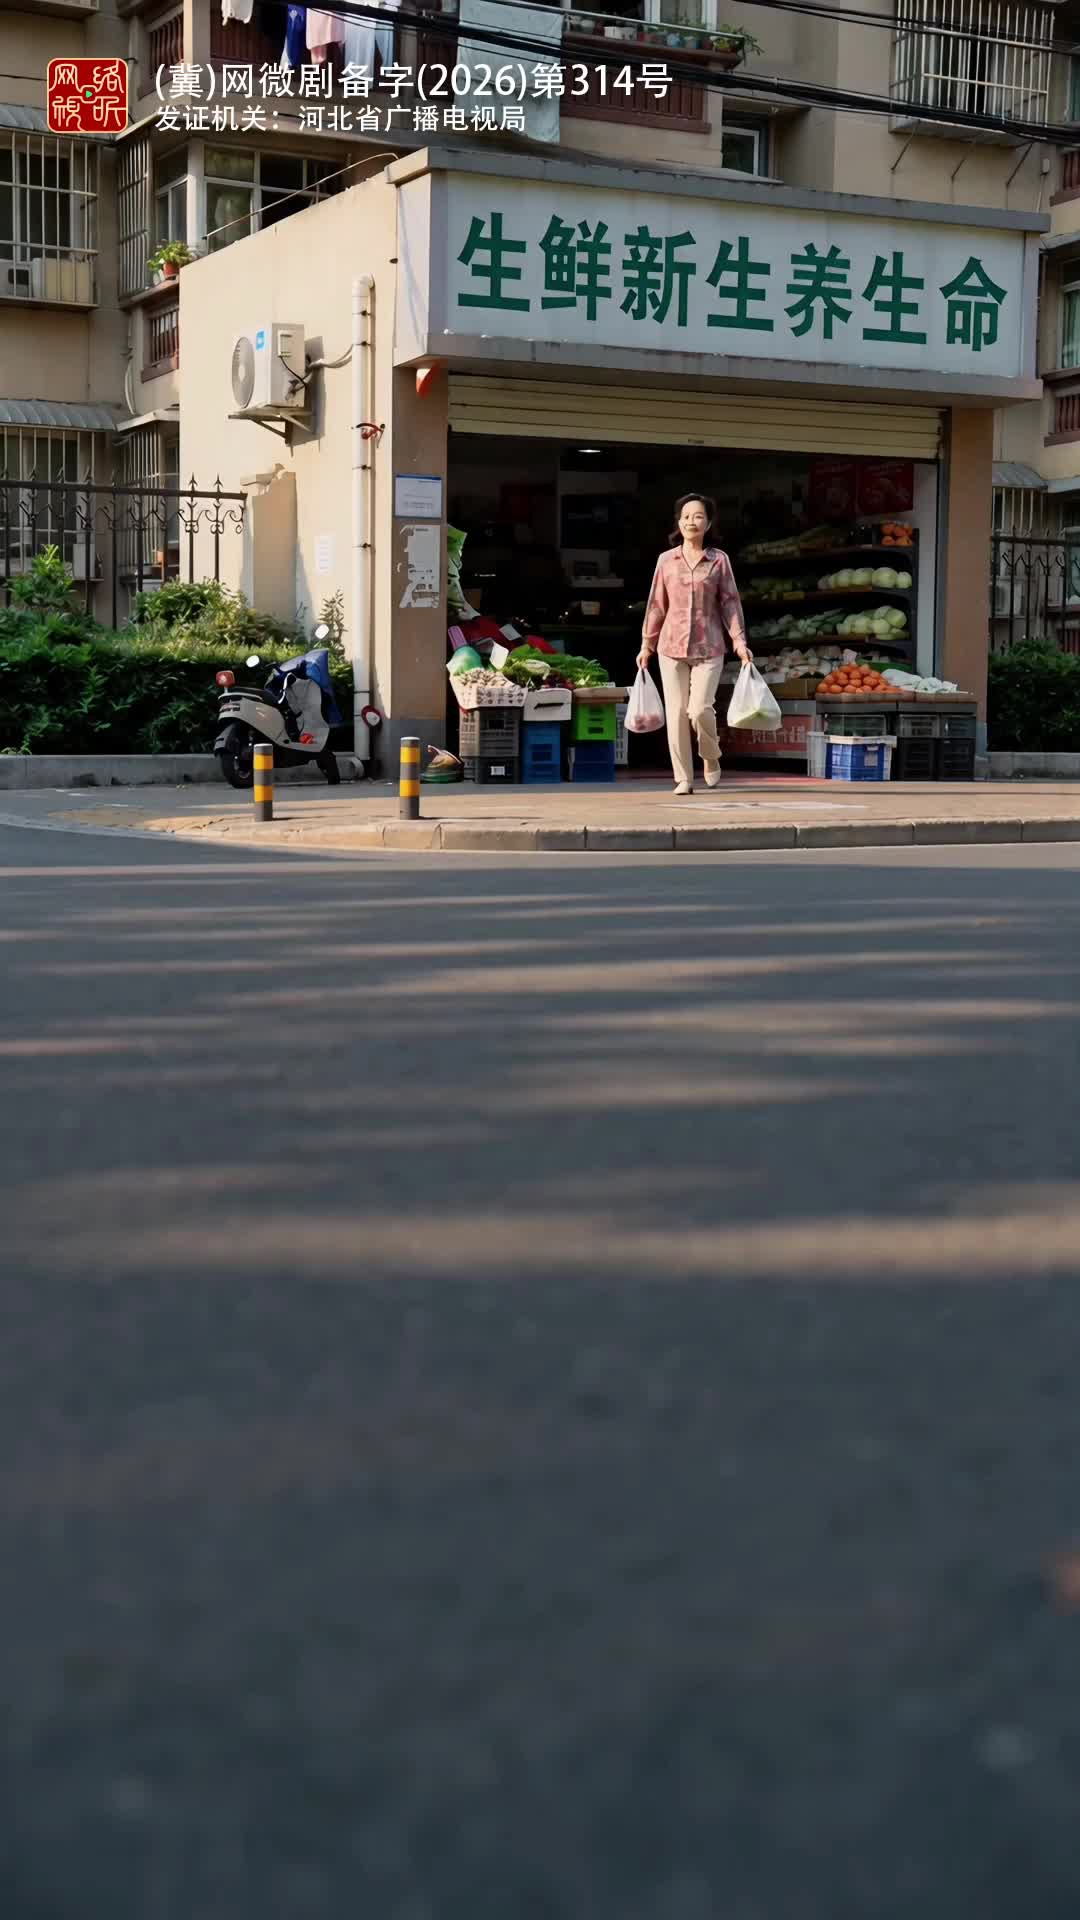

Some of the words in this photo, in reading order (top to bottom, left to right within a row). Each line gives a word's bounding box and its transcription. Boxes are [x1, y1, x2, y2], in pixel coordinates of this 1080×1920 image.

[457, 211, 1008, 352] 生鲜新生养生命
